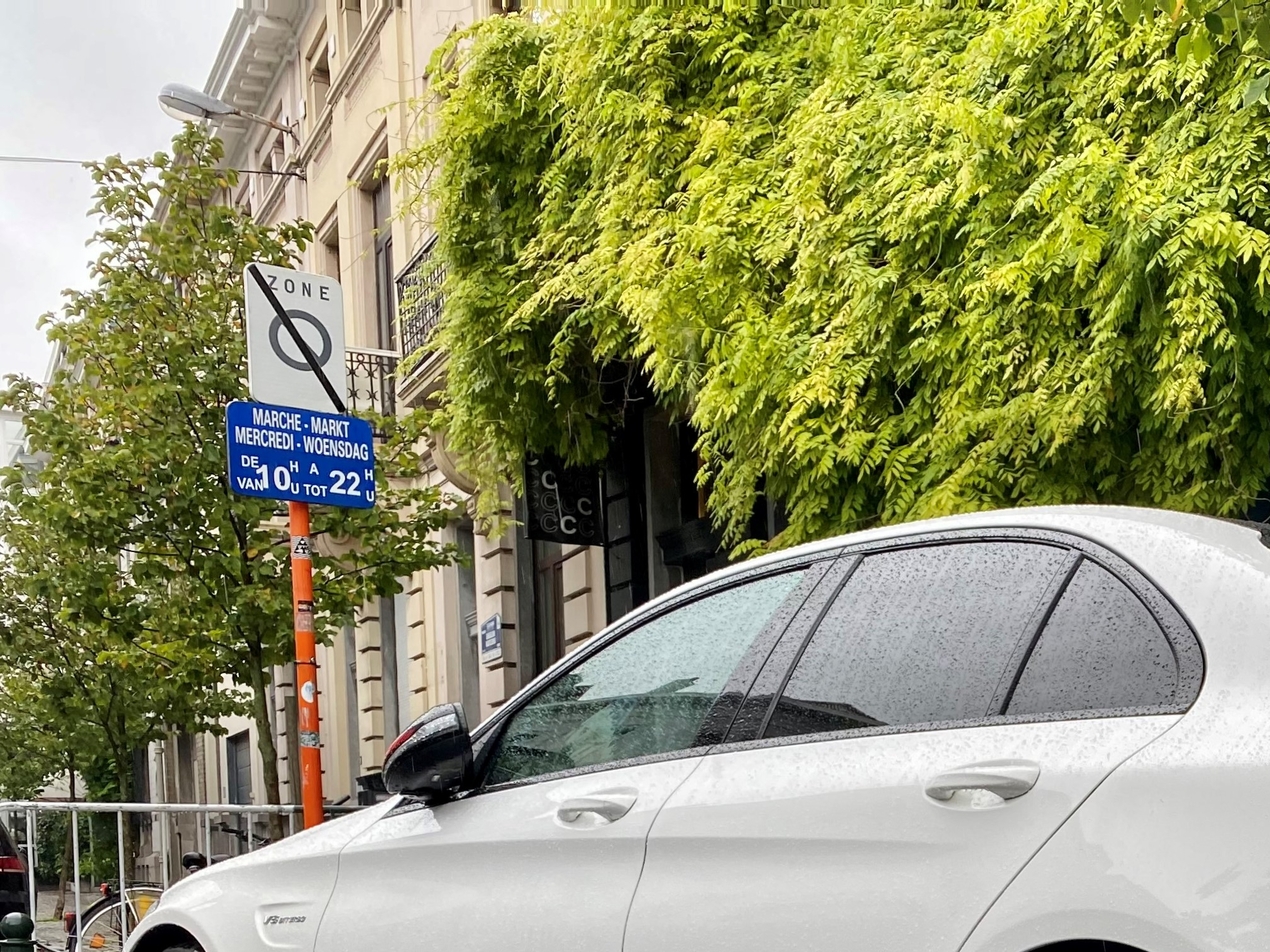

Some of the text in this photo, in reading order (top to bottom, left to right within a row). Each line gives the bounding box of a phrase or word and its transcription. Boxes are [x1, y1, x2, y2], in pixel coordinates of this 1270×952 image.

[267, 275, 330, 301] ZONE
[252, 407, 301, 432] MARCHE
[311, 416, 350, 438] MARKT
[235, 425, 294, 451] MERCREDI
[303, 436, 369, 461] WOENSDAG
[237, 476, 375, 502] VAN U TOT U
[241, 455, 373, 496] DE 10 H A 22 H
